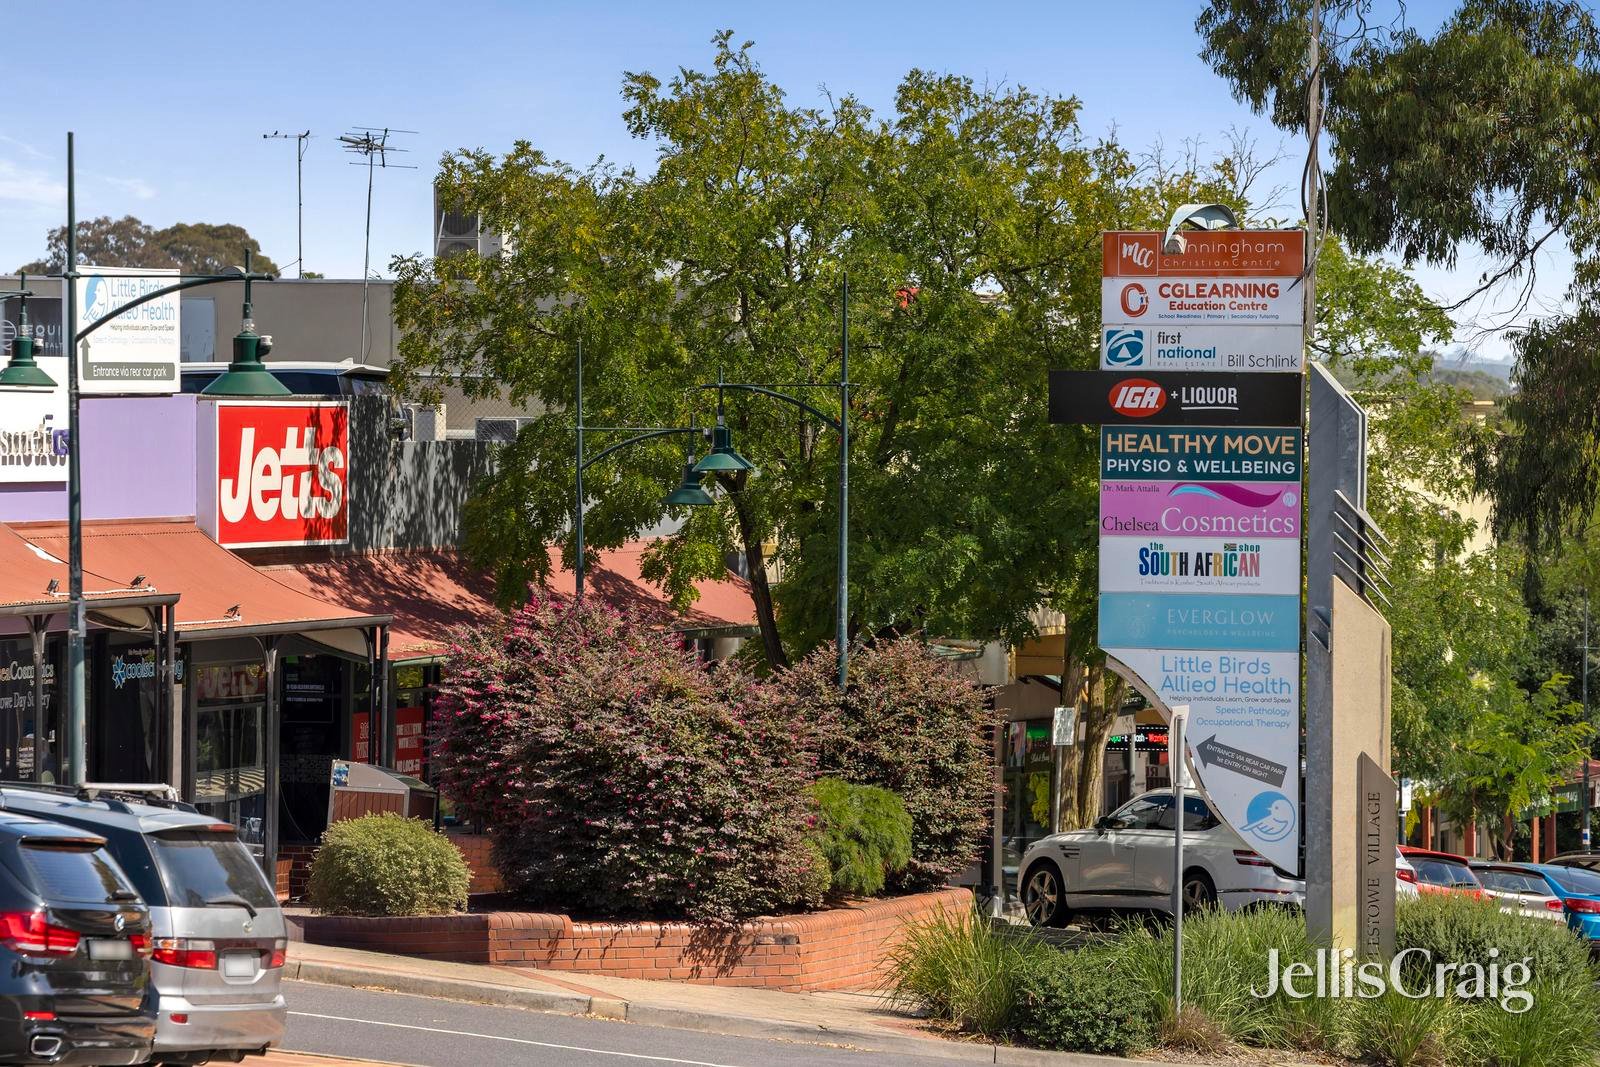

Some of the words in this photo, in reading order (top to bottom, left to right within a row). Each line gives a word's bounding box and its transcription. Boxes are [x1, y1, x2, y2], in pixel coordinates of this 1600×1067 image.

[1160, 239, 1285, 258] nningham
[111, 278, 137, 298] Little
[1158, 283, 1280, 299] CGLEARNING
[142, 301, 176, 321] Health
[1169, 301, 1227, 311] Education
[1228, 301, 1268, 311] Centre
[1157, 331, 1182, 345] first
[1157, 346, 1217, 359] national
[1227, 354, 1245, 367] Bill
[1248, 354, 1297, 369] Schlink
[92, 365, 120, 377] Entrance
[120, 366, 129, 377] via
[129, 366, 142, 377] rear
[142, 367, 152, 377] car
[153, 366, 167, 379] park
[1115, 386, 1161, 409] IGA
[1181, 386, 1238, 404] LIQUOR
[1106, 433, 1218, 454] HEALTHY
[1224, 434, 1296, 455] MOVE
[220, 426, 345, 524] Jetts
[1106, 458, 1171, 473] PHYSIO
[1176, 459, 1188, 473] &
[1193, 460, 1296, 474] WELLBEING
[1102, 484, 1114, 492] Dr.
[1115, 484, 1135, 492] Mark
[1136, 484, 1160, 493] Attalla
[1101, 515, 1160, 531] Chelsea
[1161, 506, 1295, 534] Cosmetics
[1149, 541, 1164, 551] the
[1238, 543, 1260, 553] shop
[1138, 547, 1189, 576] SOUTH
[1193, 552, 1260, 578] AFRICAN
[1167, 608, 1274, 625] EVERGLOW
[1161, 655, 1212, 673] Little
[1219, 656, 1271, 675] Birds
[1161, 674, 1216, 693] Allied
[1224, 676, 1291, 694] Health
[1169, 694, 1192, 702] Helping
[1215, 705, 1247, 716] Speech
[1248, 706, 1290, 717] Pathology
[1196, 717, 1254, 727] Occupational
[1256, 719, 1290, 729] Therapy
[1206, 743, 1236, 759] ENTRANCE
[1236, 753, 1245, 762] VIA
[1245, 757, 1259, 767] REAR
[1259, 762, 1271, 771] CAR
[1270, 766, 1285, 776] PARK
[1223, 758, 1242, 769] ENTRY
[1241, 765, 1252, 773] ON
[1252, 769, 1269, 779] RIGHT
[1367, 792, 1381, 866] VILLAGE
